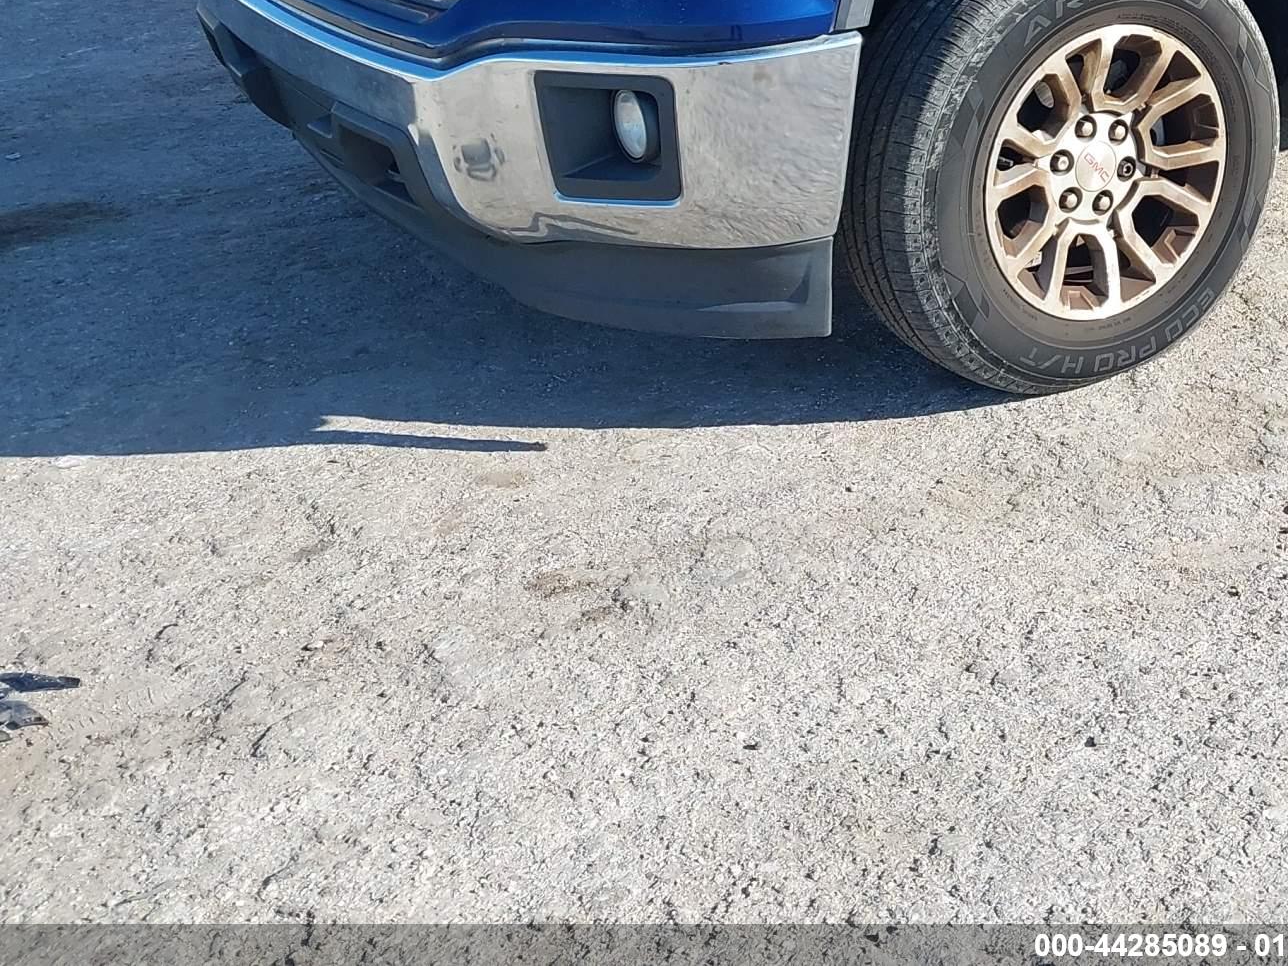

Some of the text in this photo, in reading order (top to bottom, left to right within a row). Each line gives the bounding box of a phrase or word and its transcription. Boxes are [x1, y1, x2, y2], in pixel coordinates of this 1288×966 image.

[1083, 152, 1110, 183] GMC
[1164, 286, 1216, 343] ECO
[1019, 347, 1084, 374] H/T
[1093, 336, 1157, 373] PRO
